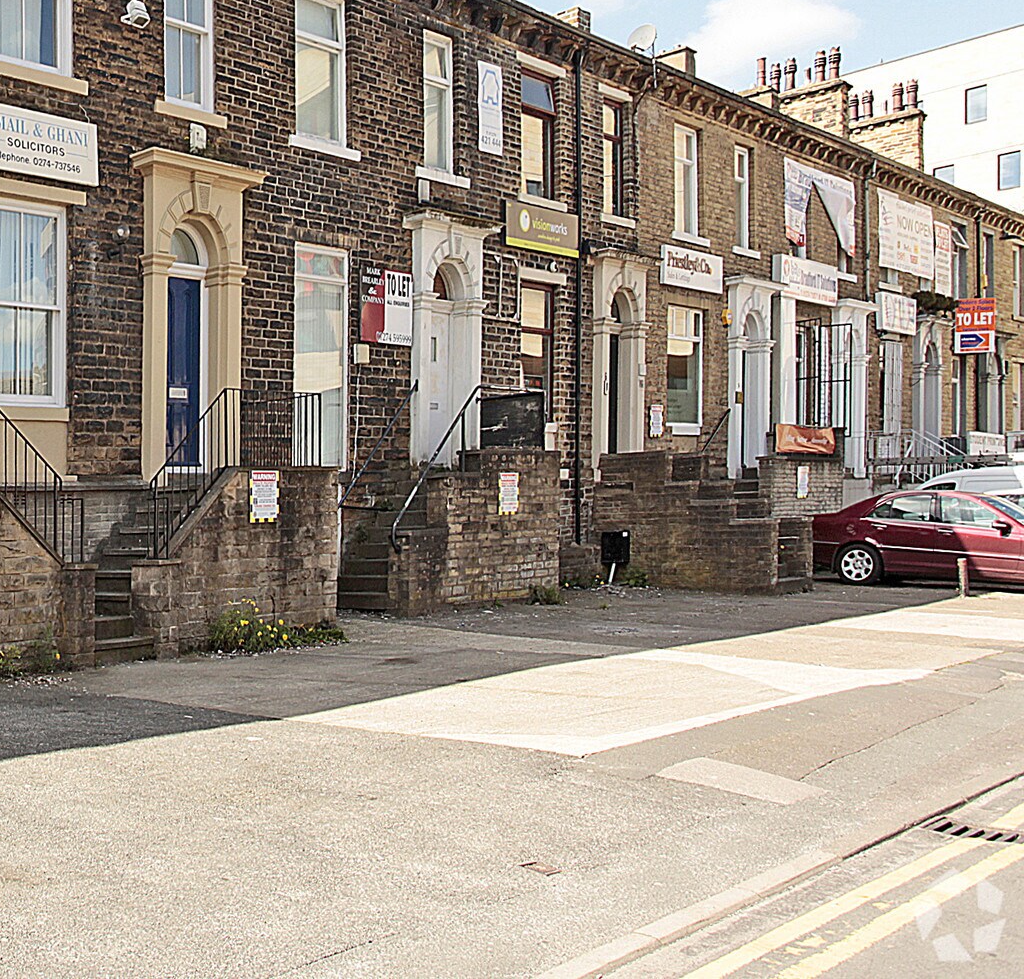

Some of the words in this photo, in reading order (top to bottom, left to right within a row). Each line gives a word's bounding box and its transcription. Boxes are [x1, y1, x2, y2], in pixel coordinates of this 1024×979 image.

[33, 123, 43, 138] &
[47, 126, 89, 147] GHANI
[7, 137, 66, 156] SOLICITORS
[33, 157, 81, 173] 0274-737546
[532, 218, 568, 236] visionworks
[897, 215, 914, 232] NOW
[915, 220, 931, 238] OPEN
[367, 267, 381, 275] MARK
[368, 287, 377, 295] &
[387, 273, 396, 296] TO
[398, 275, 410, 298] LET
[362, 295, 384, 304] COMPANY
[957, 313, 972, 326] TO
[974, 312, 993, 326] LET
